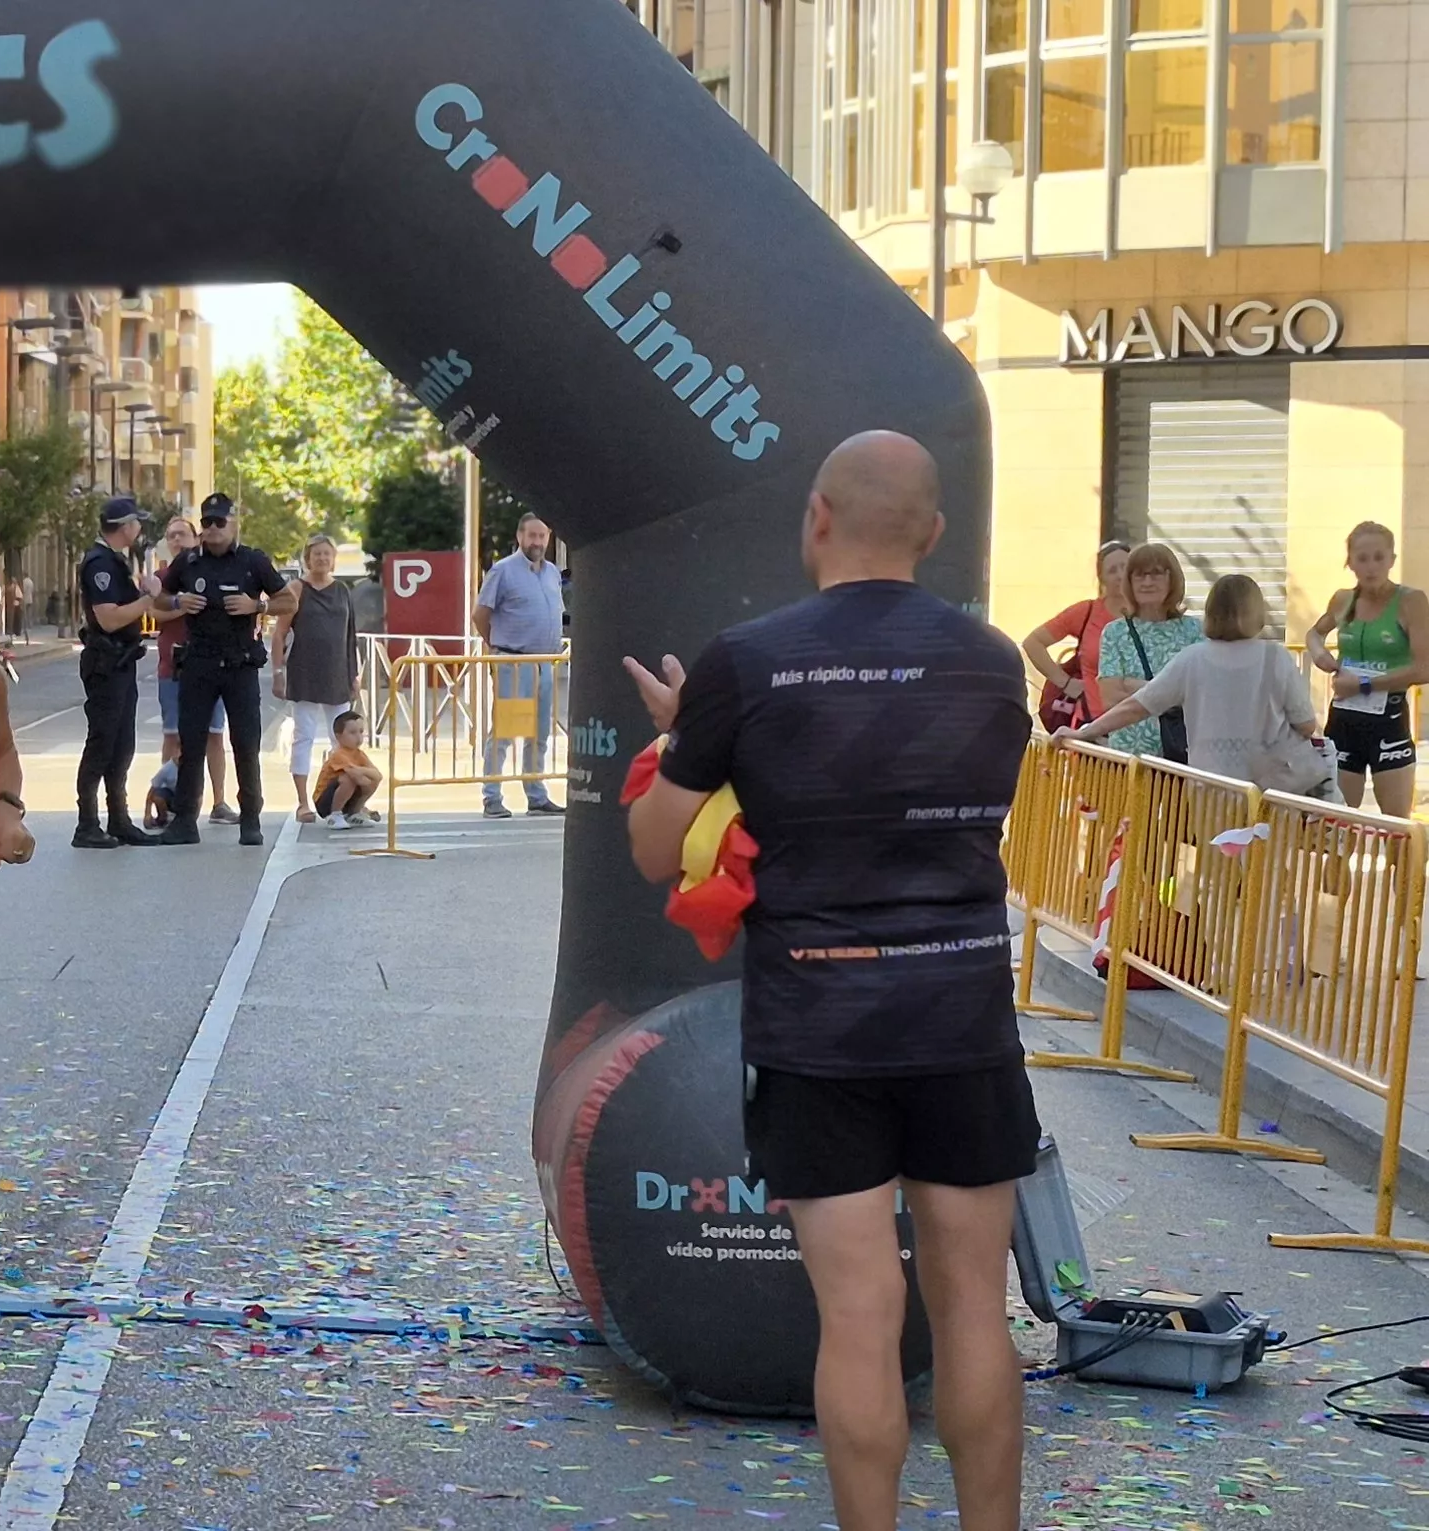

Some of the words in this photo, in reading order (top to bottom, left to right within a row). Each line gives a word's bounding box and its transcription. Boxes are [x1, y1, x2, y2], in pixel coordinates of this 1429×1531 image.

[1059, 298, 1340, 362] MANGO
[414, 349, 473, 412] mits
[772, 669, 804, 688] Más
[807, 666, 855, 684] rápido
[859, 668, 888, 683] que
[891, 667, 926, 683] ayer
[571, 717, 618, 757] mits
[1379, 748, 1412, 762] PRO
[906, 807, 956, 820] menos
[880, 943, 941, 957] TRINIDAD
[701, 1222, 765, 1240] Servicio
[769, 1223, 792, 1241] de
[666, 1241, 713, 1259] vídeo
